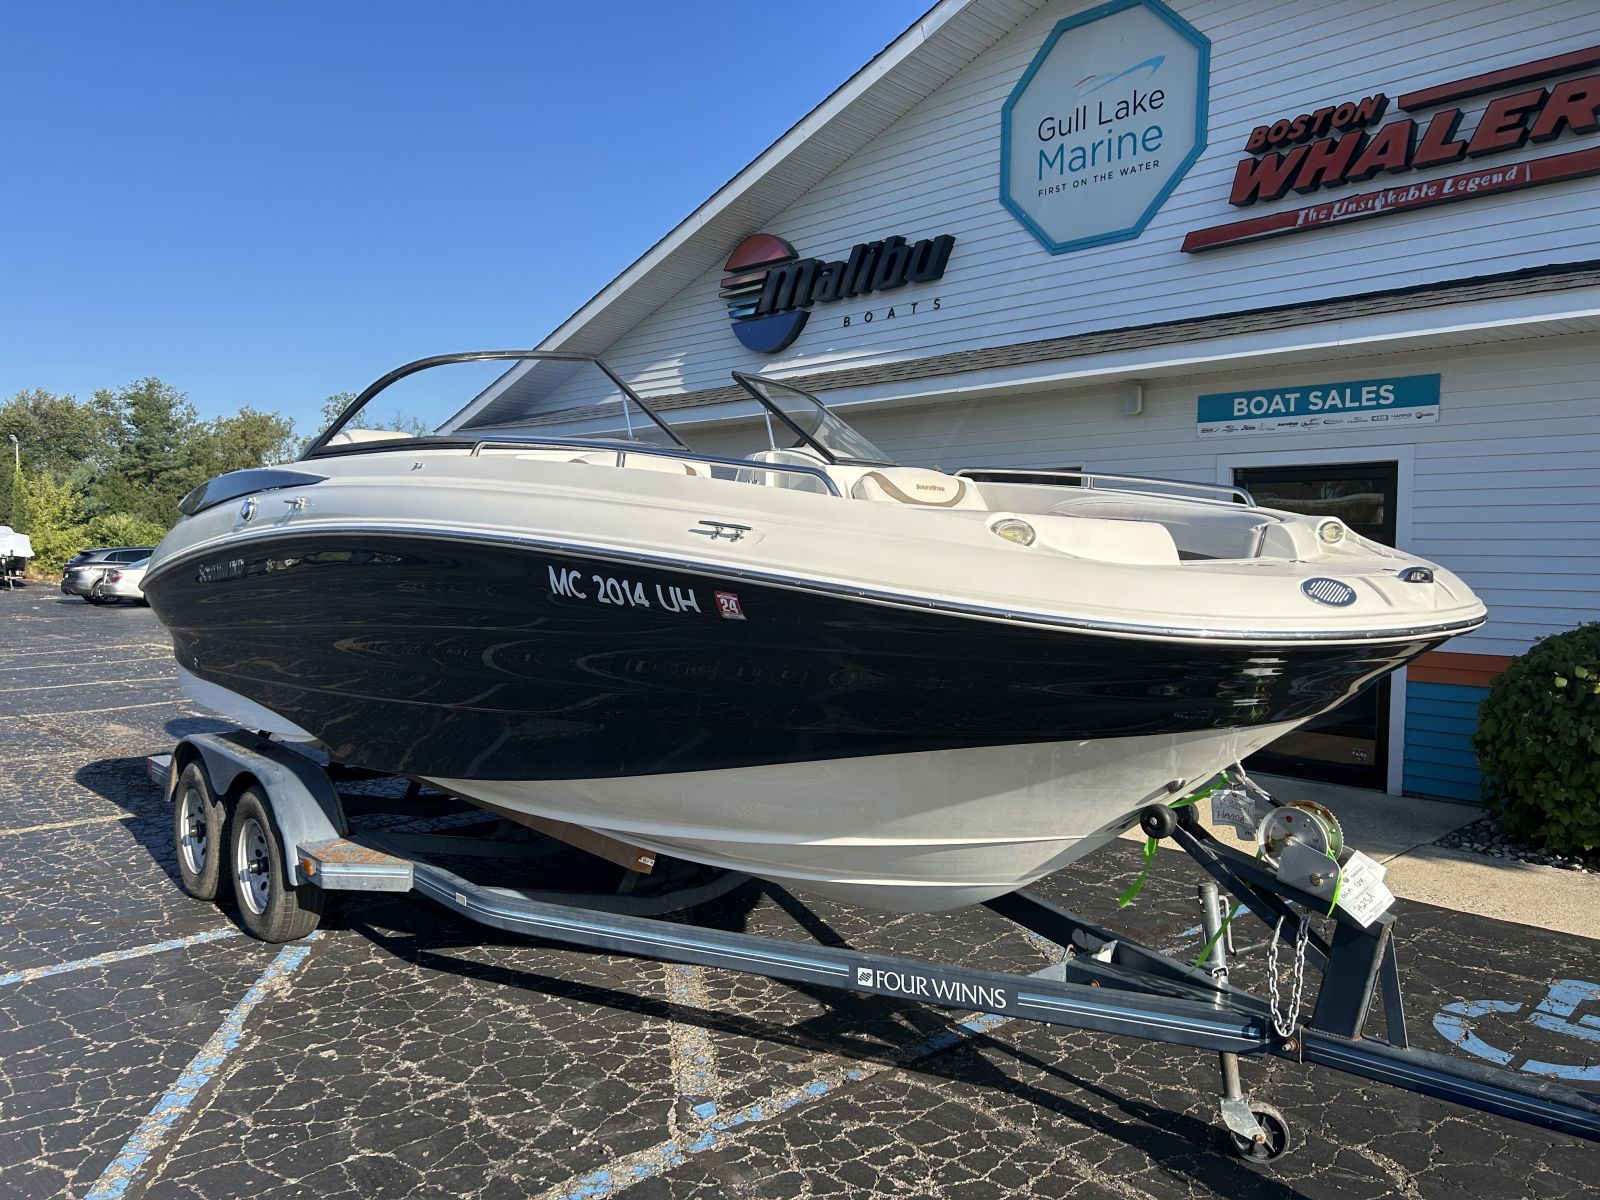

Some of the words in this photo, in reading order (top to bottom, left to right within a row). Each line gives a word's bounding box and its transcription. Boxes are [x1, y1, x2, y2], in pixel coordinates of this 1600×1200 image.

[1038, 105, 1086, 141] Gull
[1098, 89, 1165, 125] Lake
[1244, 93, 1390, 152] BOSTON
[1038, 125, 1163, 181] Marine
[1229, 75, 1600, 207] WHALER
[1038, 183, 1067, 197] FIRST
[1072, 178, 1088, 189] ON
[1093, 171, 1114, 183] THE
[1119, 160, 1160, 177] WATER
[1296, 209, 1327, 228] The
[1441, 166, 1518, 195] Legend
[843, 298, 941, 327] BOATS
[1233, 392, 1301, 416] BOAT
[1308, 385, 1395, 410] SALES
[548, 565, 587, 599] MC
[592, 575, 650, 608] 2014
[655, 584, 702, 613] UH
[720, 598, 739, 614] 24
[876, 970, 931, 997] FOUR
[930, 978, 1007, 1009] WINNS
